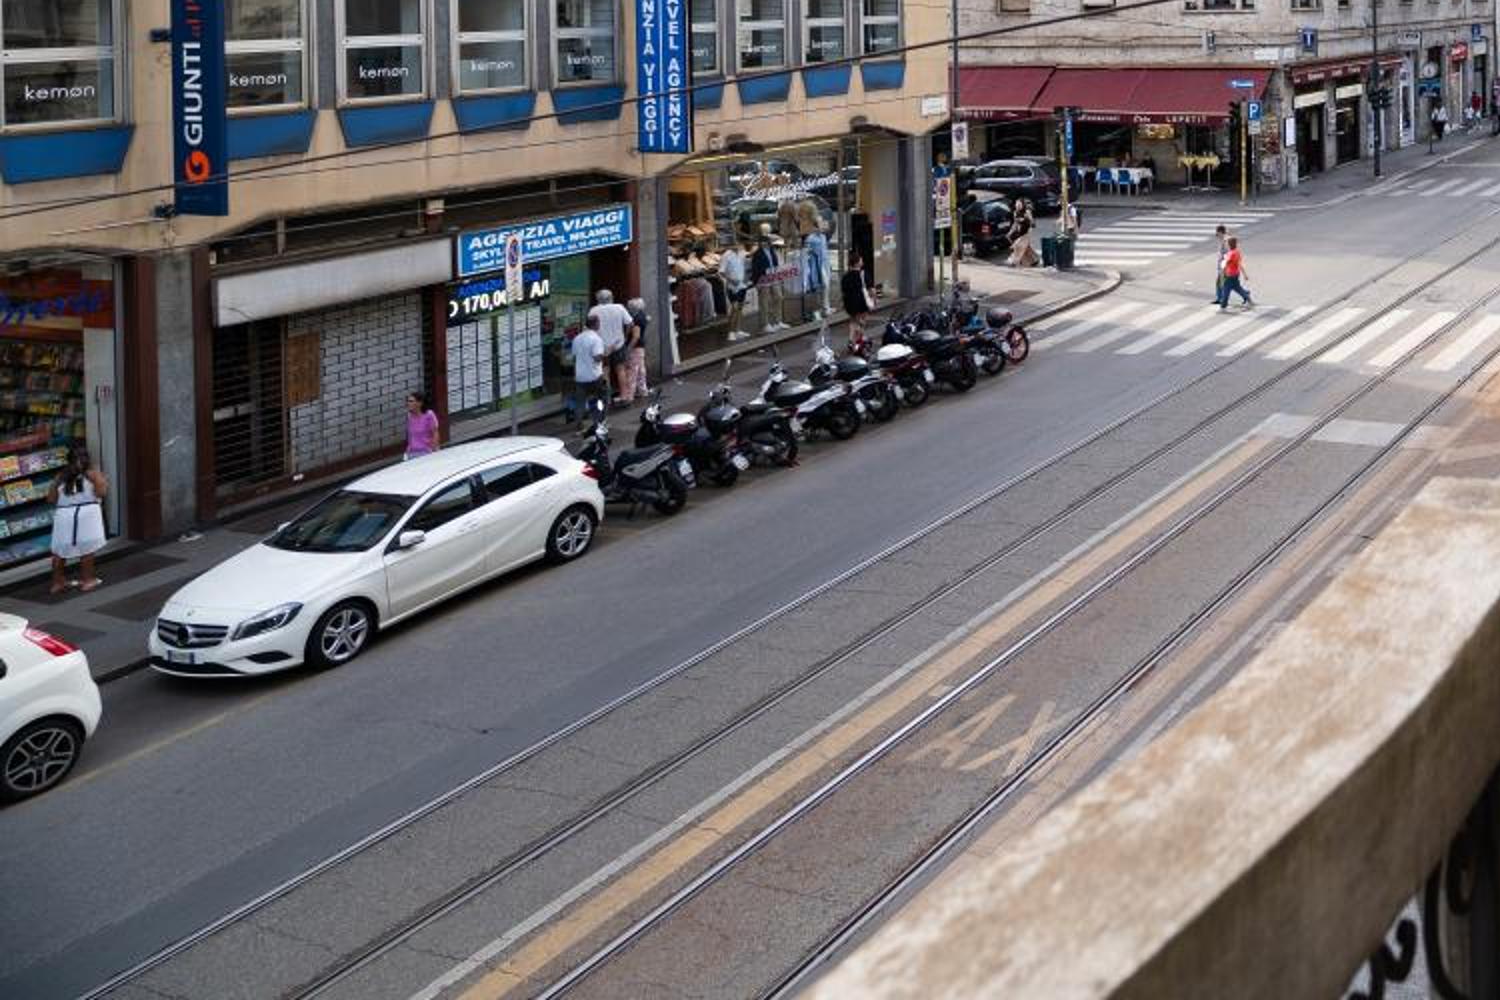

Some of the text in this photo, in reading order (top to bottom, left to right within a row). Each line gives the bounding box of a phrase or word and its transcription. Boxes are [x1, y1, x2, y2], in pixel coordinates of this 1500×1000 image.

[182, 42, 204, 146] GIUNTI
[643, 63, 657, 147] VIAGGI
[667, 57, 681, 147] AGENCY
[1249, 103, 1259, 118] P
[525, 236, 566, 251] TRAVEL
[562, 210, 624, 233] VIAGGI
